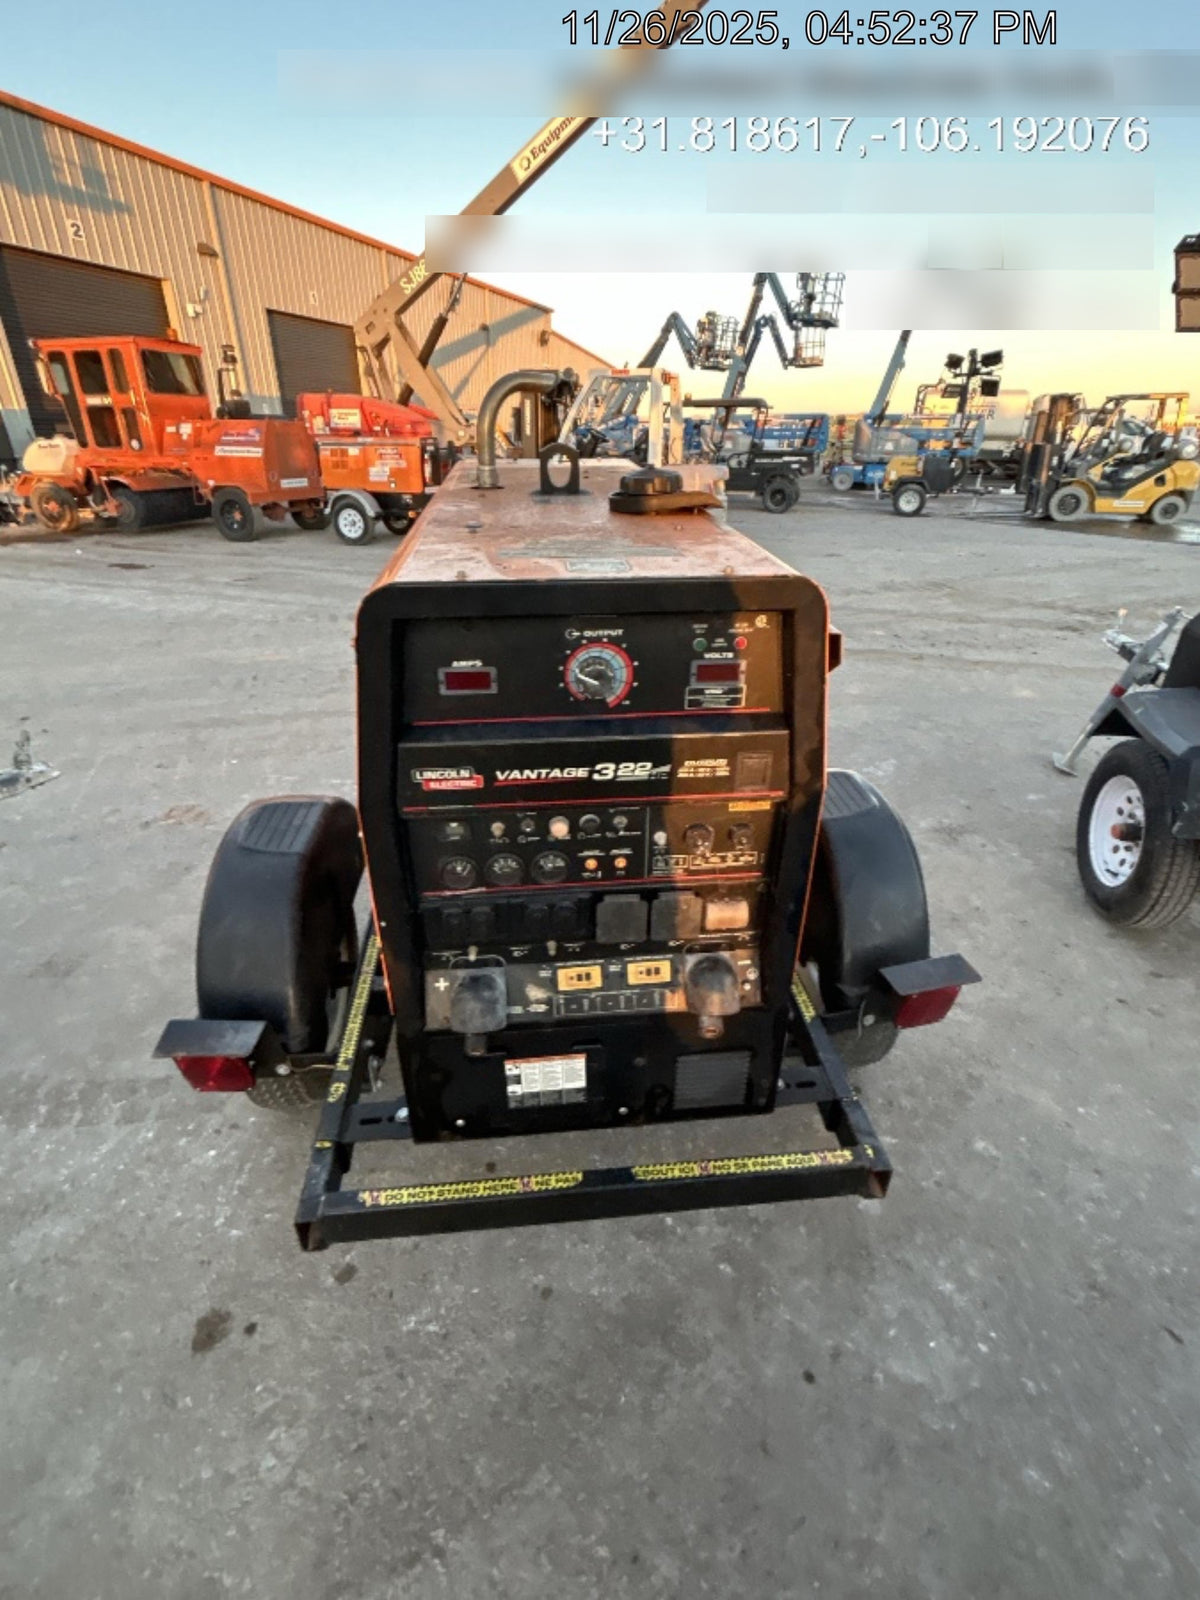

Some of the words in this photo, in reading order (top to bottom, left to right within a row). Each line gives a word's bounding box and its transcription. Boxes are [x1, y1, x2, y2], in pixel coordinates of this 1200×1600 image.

[70, 222, 84, 239] 2
[582, 629, 624, 637] OUTPUT
[415, 768, 471, 781] LINCOLN
[495, 767, 590, 781] VANTAGE
[591, 761, 654, 781] 322
[428, 778, 478, 790] ELECTRIC
[385, 1193, 404, 1201] DO
[406, 1189, 435, 1199] NOT
[436, 1184, 480, 1197] STAND
[483, 1181, 517, 1193] HERE
